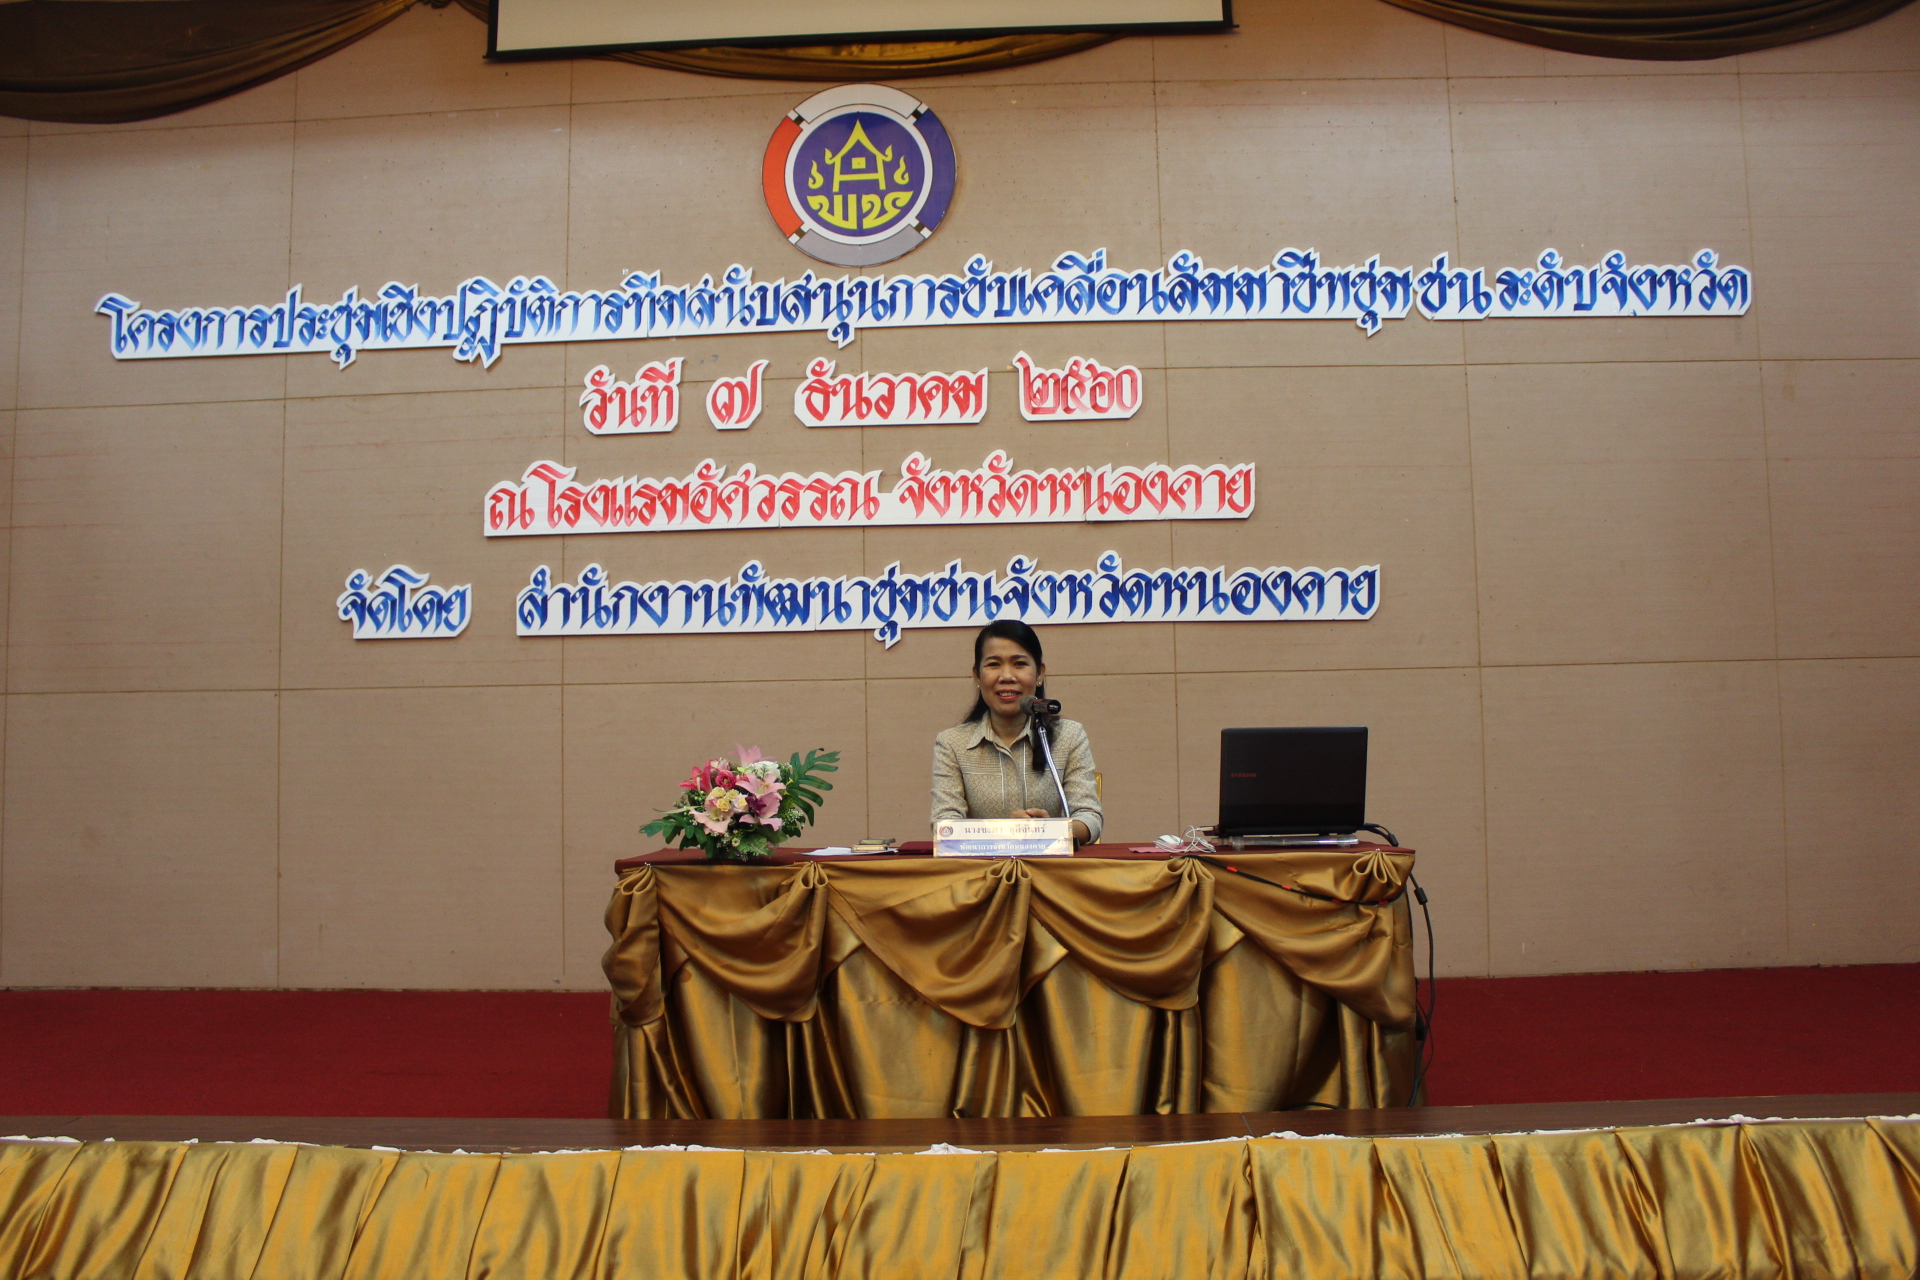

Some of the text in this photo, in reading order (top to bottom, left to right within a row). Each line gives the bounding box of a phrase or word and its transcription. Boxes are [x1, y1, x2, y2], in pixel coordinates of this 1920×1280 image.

[582, 357, 1138, 430] วันที่ ๗ ธันวาคม ๒๕๖๐
[899, 455, 1253, 518] จังหวัดหนองคาย
[341, 554, 1379, 641] จัดโดย สำนักงานพัฒนาชุมชนจังหวัดหนองคาย
